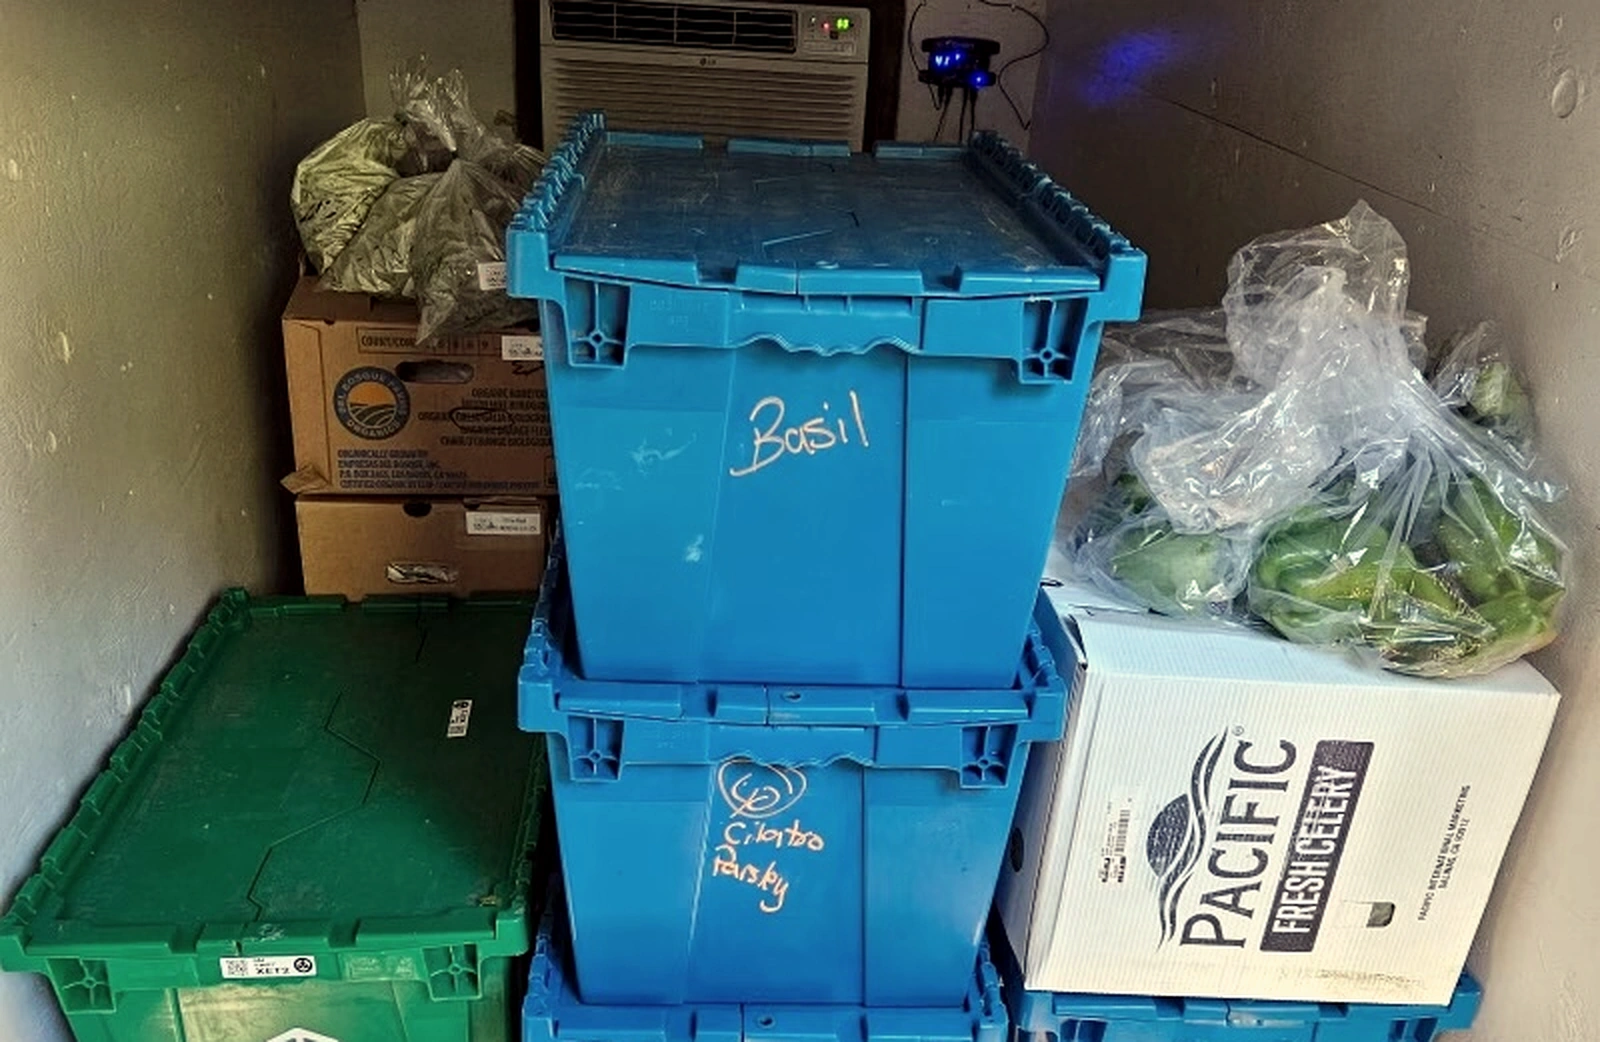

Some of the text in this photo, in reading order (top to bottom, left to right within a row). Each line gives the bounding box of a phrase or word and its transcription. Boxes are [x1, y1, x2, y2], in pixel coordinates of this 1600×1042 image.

[729, 389, 869, 476] Basil
[1178, 738, 1298, 949] PACIFIC
[1271, 765, 1358, 934] FRESH CELERY
[1447, 784, 1471, 831] MARKETING
